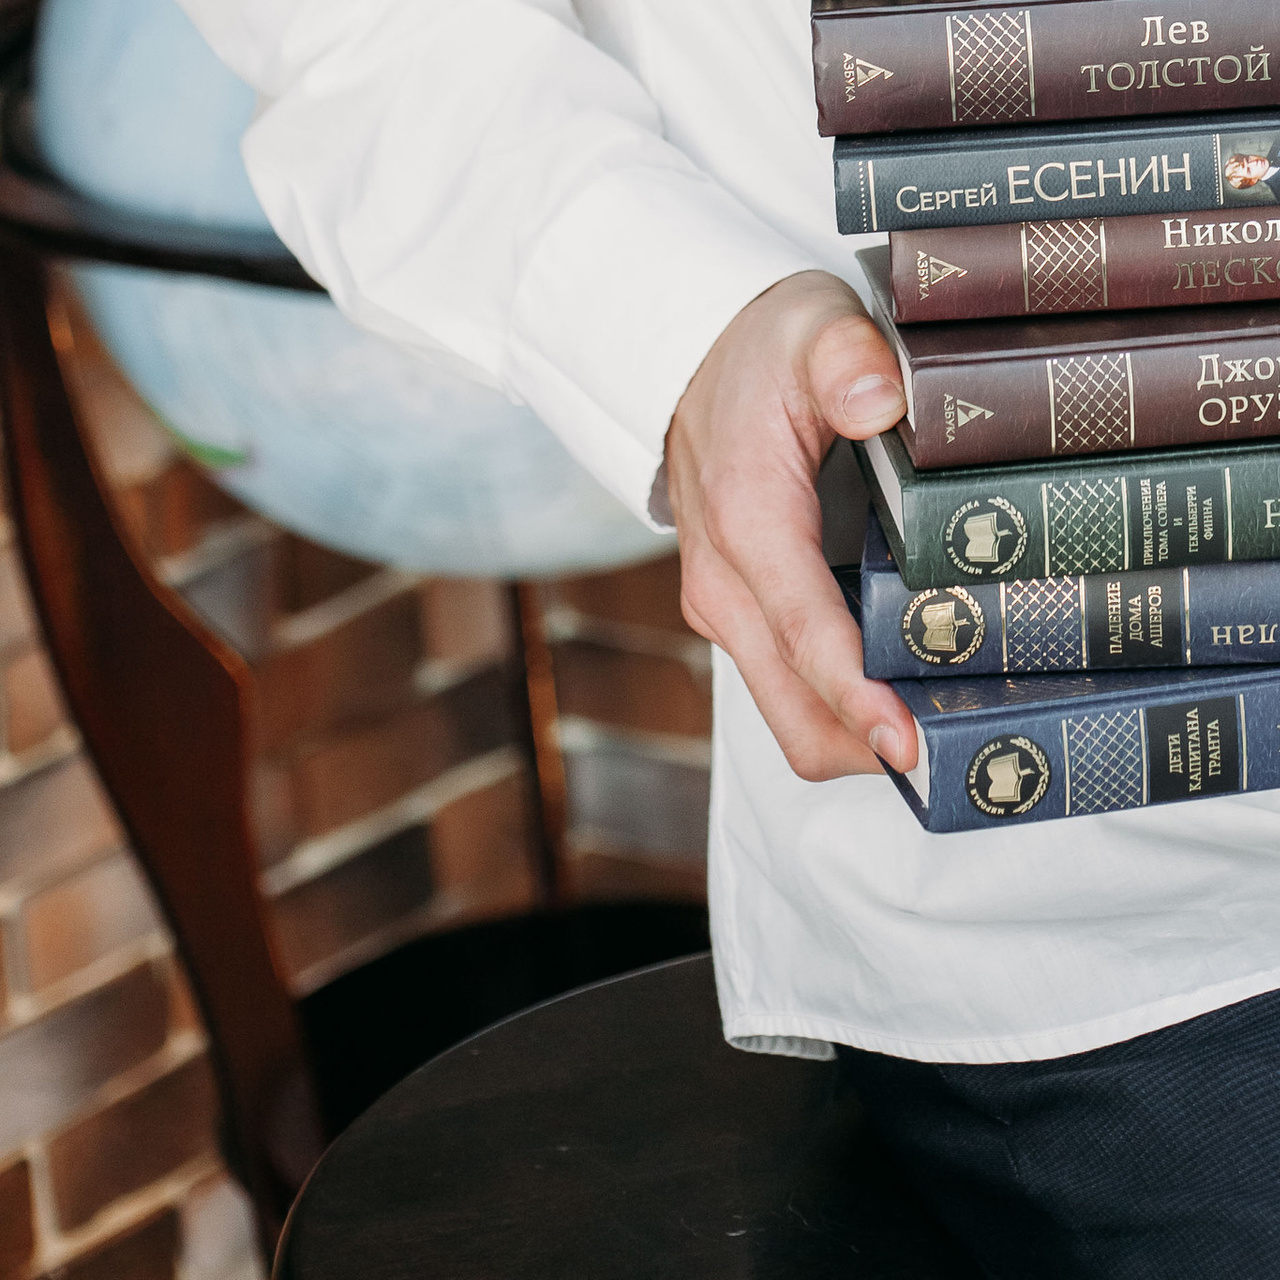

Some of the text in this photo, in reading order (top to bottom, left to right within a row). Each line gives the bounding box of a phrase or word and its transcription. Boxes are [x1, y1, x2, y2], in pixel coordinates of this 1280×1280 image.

[1140, 16, 1209, 47] Лев
[843, 52, 856, 103] АЗБУКА
[1081, 45, 1272, 93] ТОЛСТОЙ
[1007, 152, 1192, 204] ЕСЕНИН
[916, 250, 930, 301] АЗБУКА
[943, 393, 957, 444] АЗБУКА
[1140, 478, 1154, 566] ПРИКЛЮЧЕНИЯ
[1154, 480, 1169, 562] ТОМА СОЙЕРА
[1174, 517, 1183, 526] И
[1186, 485, 1199, 553] ГЕКЛЬБЕРРИ
[1202, 497, 1214, 540] ФИННА
[1107, 581, 1123, 655] ПАДЕНИЕ
[1128, 594, 1144, 642] ДОМА
[1148, 585, 1163, 648] АШЕРОВ
[1168, 733, 1183, 774] ДЕТИ
[1186, 707, 1202, 792] КАПИТАНА
[1208, 718, 1221, 777] ГРАНТА
